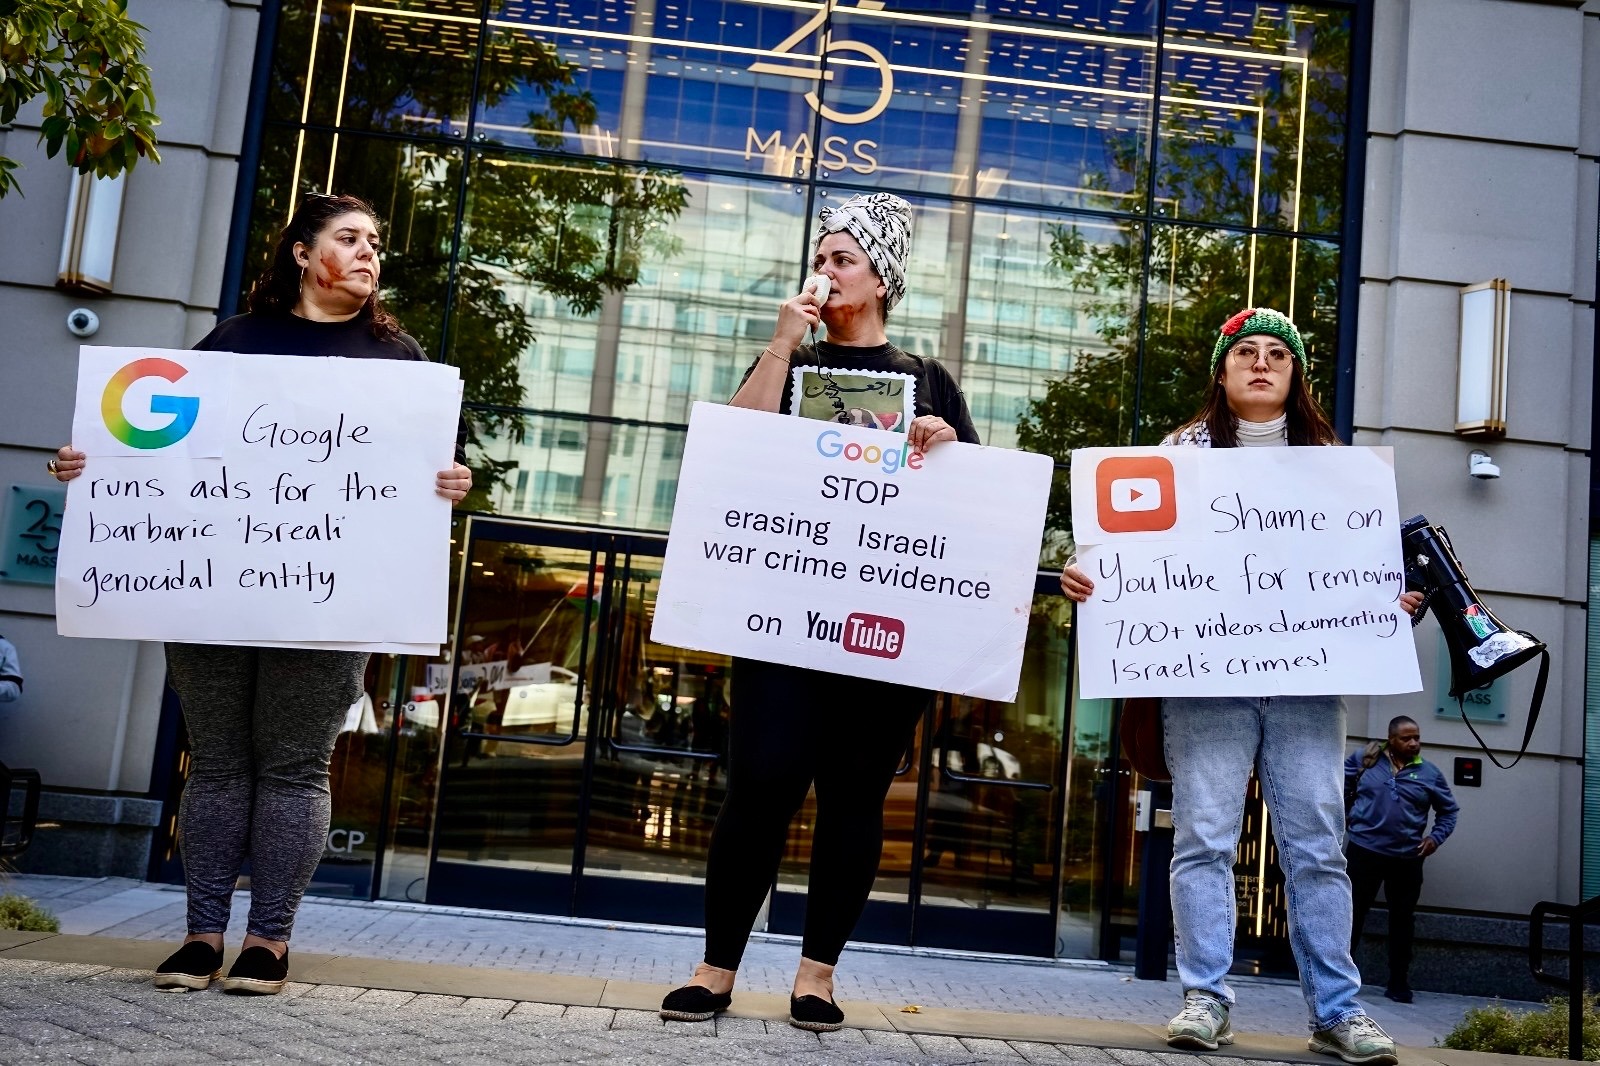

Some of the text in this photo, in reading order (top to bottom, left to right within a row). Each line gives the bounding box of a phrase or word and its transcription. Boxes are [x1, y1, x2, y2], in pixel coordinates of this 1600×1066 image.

[744, 127, 878, 174] MASS
[242, 404, 372, 463] Google
[816, 429, 925, 474] Google
[90, 466, 398, 505] runs ads for the
[821, 475, 900, 506] STOP
[90, 512, 217, 544] barbaric
[725, 509, 948, 560] erasing Israeli
[1210, 493, 1383, 534] Shame on
[16, 553, 57, 568] MASS
[703, 541, 991, 600] war crime evidence
[1099, 552, 1403, 604] YouTube for removing
[77, 558, 335, 608] genocidal entity
[747, 611, 902, 656] on YouTube
[1106, 609, 1398, 649] 700+ videos documenting
[1226, 647, 1328, 678] crimes!
[1453, 691, 1492, 705] ASS
